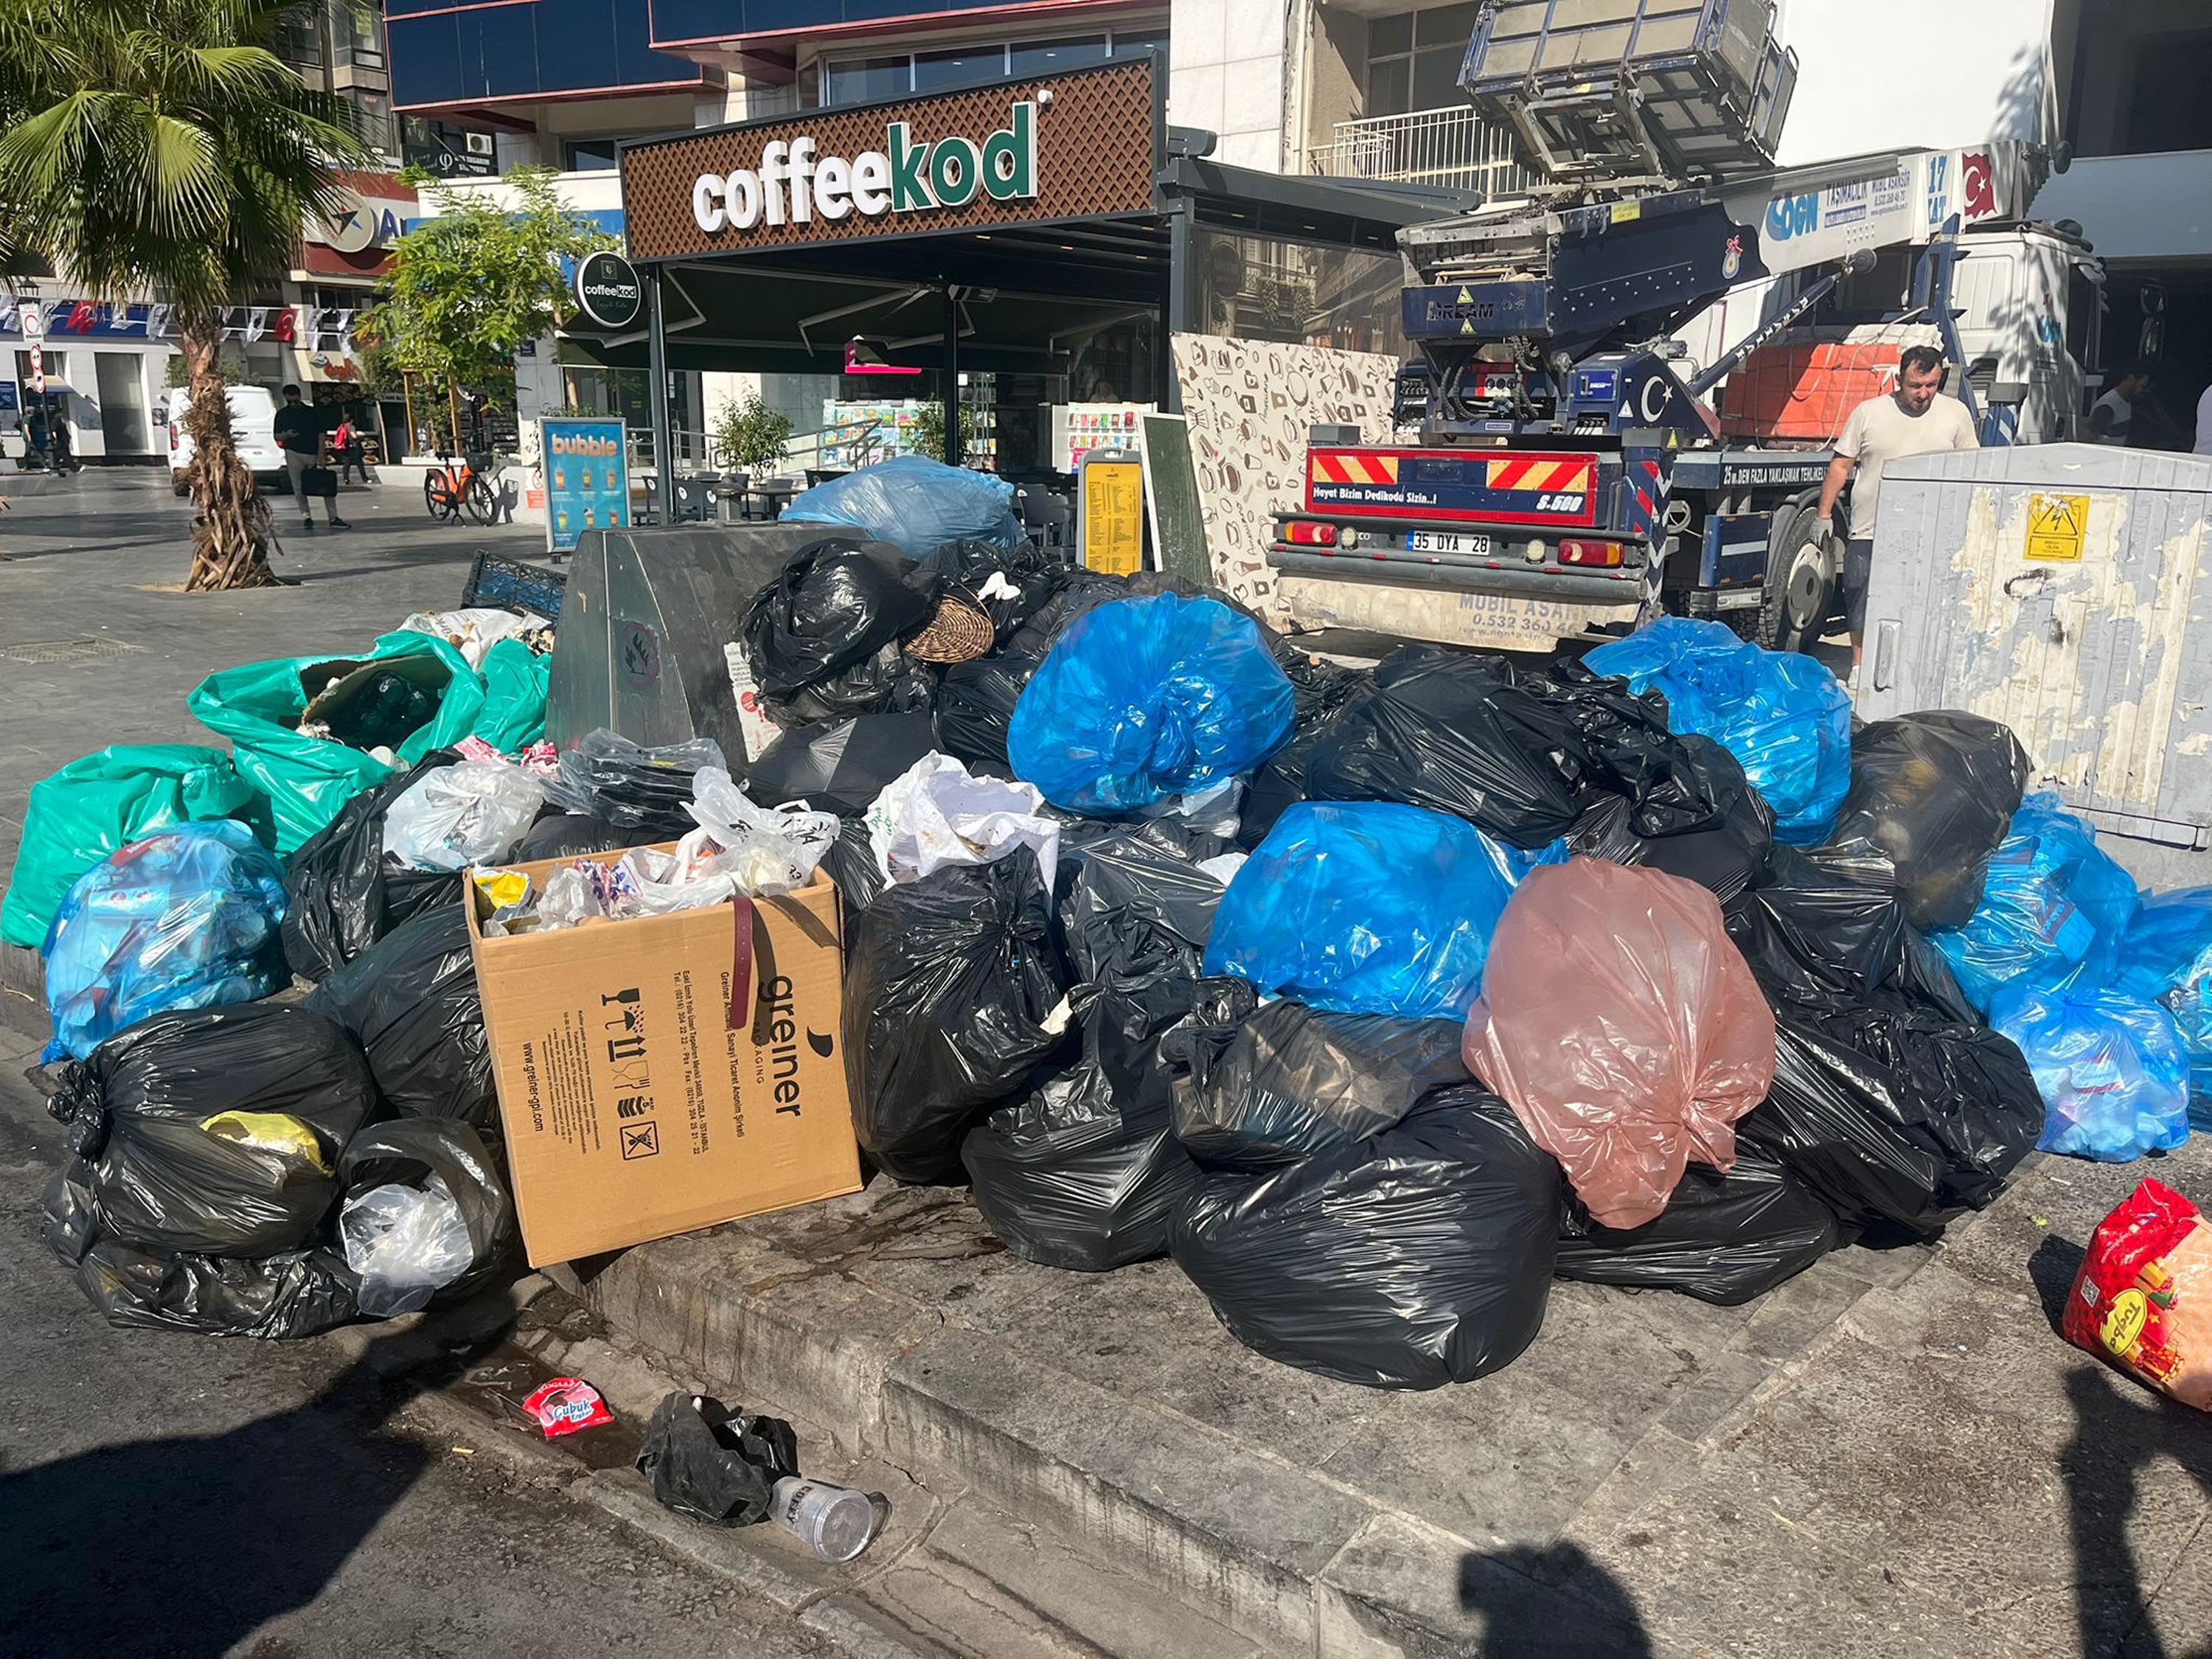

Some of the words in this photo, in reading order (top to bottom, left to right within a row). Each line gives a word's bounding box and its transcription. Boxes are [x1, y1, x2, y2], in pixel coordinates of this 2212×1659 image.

[692, 101, 1037, 234] coffeekod
[1928, 155, 1947, 194] 17
[585, 284, 636, 298] coffeekod
[551, 433, 618, 457] bubble
[1750, 468, 1768, 484] FAZLA
[1768, 467, 1800, 484] YAKLAŞMAK
[1313, 487, 1338, 499] Hayat
[1339, 488, 1363, 500] Bizim
[1365, 490, 1405, 502] Dedikodu
[1414, 532, 1430, 549] 35
[1437, 535, 1459, 552] DYA
[1472, 536, 1488, 553] 28
[1472, 613, 1516, 628] 0.532
[720, 972, 731, 999] Greiner
[679, 1026, 686, 1034] 22
[725, 1033, 737, 1059] Sanayi
[754, 1021, 765, 1085] PACKAGING
[757, 975, 801, 1118] greiner
[686, 1001, 694, 1015] Yolu
[698, 1099, 706, 1119] TUZLA
[729, 1060, 740, 1084] Ticaret
[521, 1043, 546, 1133] www.greiner-gpi.com
[732, 1085, 742, 1113] Anonim
[734, 1114, 745, 1138] Şirketi
[553, 1399, 592, 1421] Çubuk
